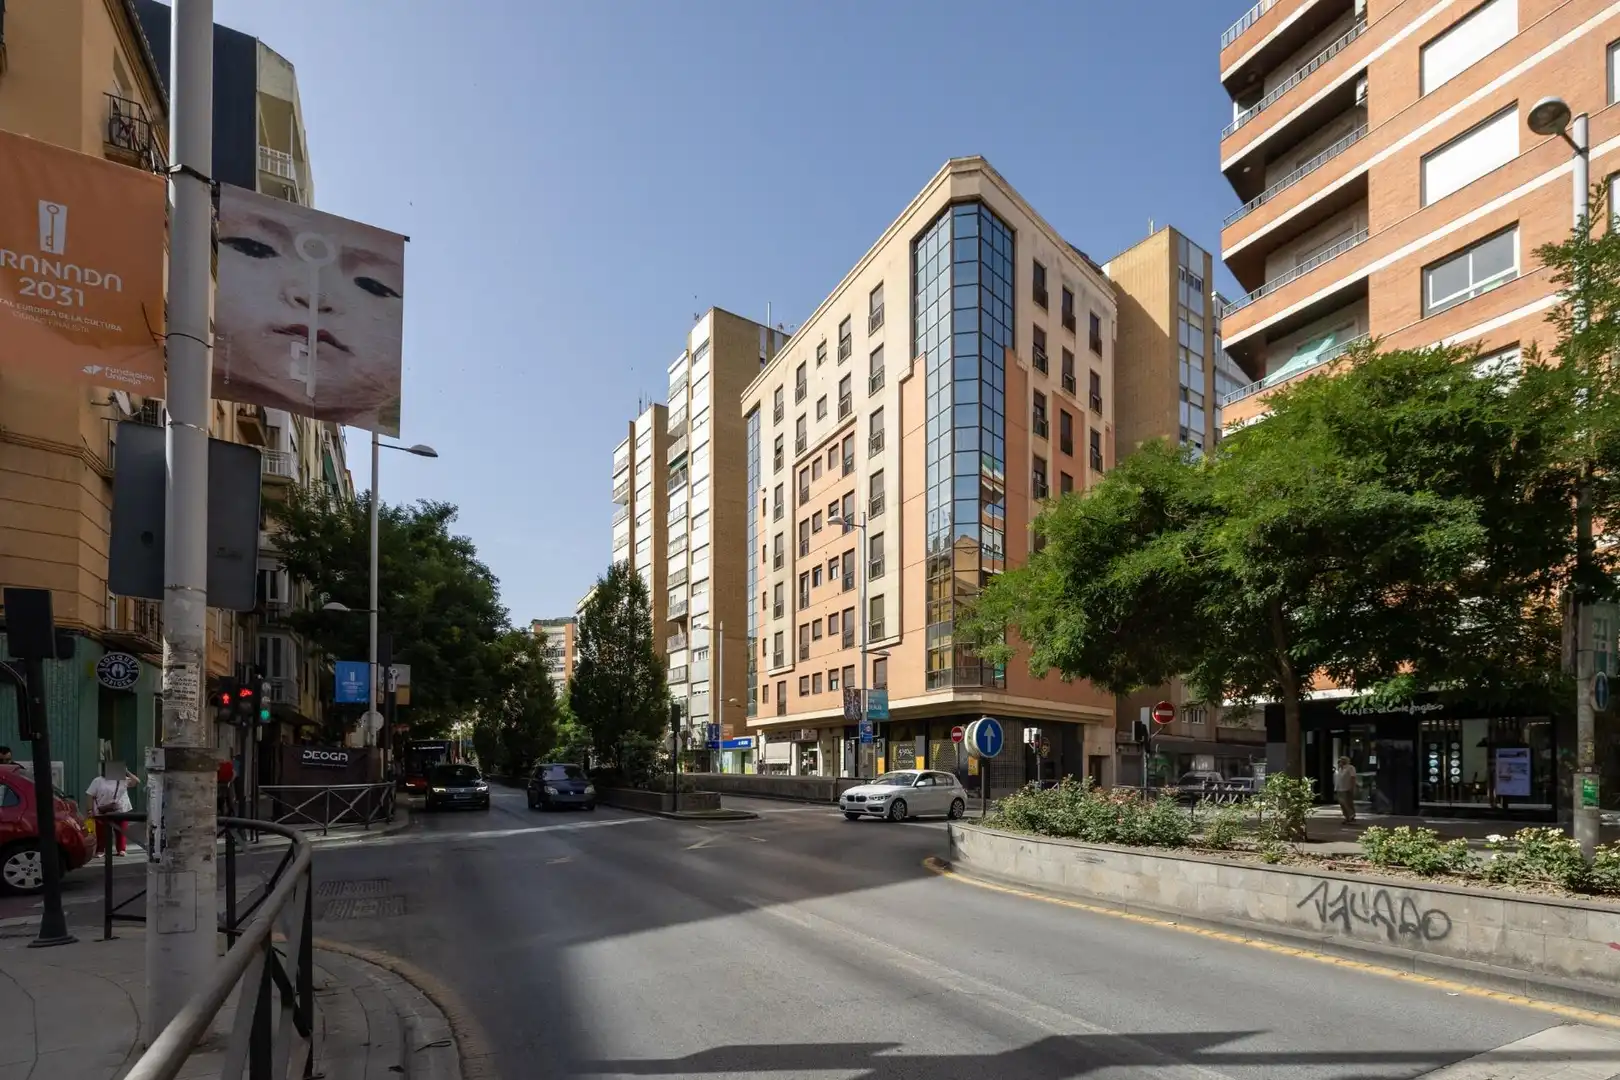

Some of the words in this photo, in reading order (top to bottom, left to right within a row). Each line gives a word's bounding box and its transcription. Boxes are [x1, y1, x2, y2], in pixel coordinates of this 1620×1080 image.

[0, 248, 122, 292] RANADA
[19, 277, 85, 307] 2031
[16, 303, 56, 317] EUROPEA
[83, 317, 122, 332] CULTURA
[100, 655, 138, 668] BOUQUET
[103, 677, 133, 687] ORIGEN
[302, 749, 349, 762] DEOGA
